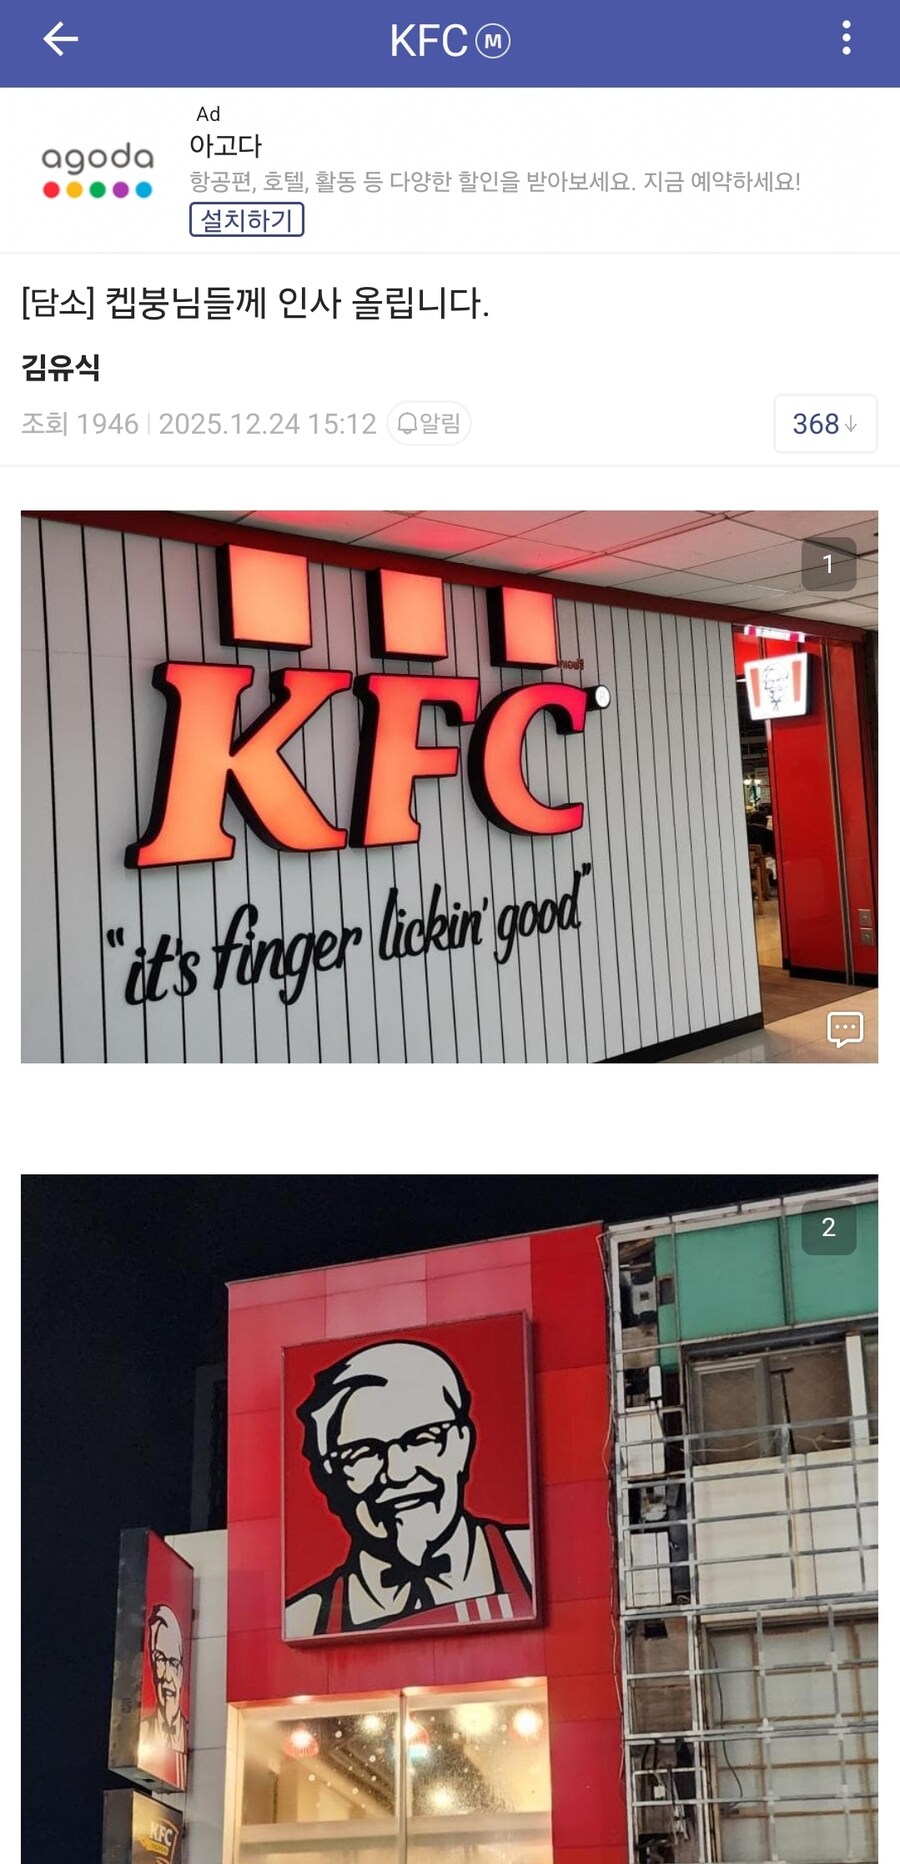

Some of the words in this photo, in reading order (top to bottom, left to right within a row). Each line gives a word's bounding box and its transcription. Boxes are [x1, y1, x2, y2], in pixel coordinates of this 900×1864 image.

[392, 24, 467, 57] KFC
[196, 106, 220, 121] Ad
[190, 134, 262, 158] 아고다
[42, 142, 154, 176] agoda
[190, 171, 256, 193] 항공편,
[264, 171, 308, 193] 호텔,
[316, 171, 356, 193] 활동
[364, 172, 383, 193] 등
[391, 171, 452, 192] 다양한
[459, 171, 520, 192] 할인을
[528, 171, 635, 192] 받아보세요.
[644, 171, 684, 192] 지금
[692, 171, 799, 192] 예약하세요!
[201, 209, 291, 233] 설치하기
[23, 286, 94, 320] [담소]
[106, 287, 265, 320] 켑붕님들께
[279, 287, 341, 319] 인사
[352, 287, 488, 320] 올립니다.
[22, 354, 99, 382] 김유식
[22, 412, 66, 436] 조회
[78, 413, 138, 434] 1946
[160, 413, 300, 434] 2025.12.24
[309, 413, 376, 434] 15:12
[421, 413, 459, 434] 알림
[794, 413, 839, 434] 368
[124, 661, 587, 870] KFC
[213, 903, 362, 1005] finger
[379, 884, 489, 961] lickin'
[149, 1822, 174, 1847] KFC
